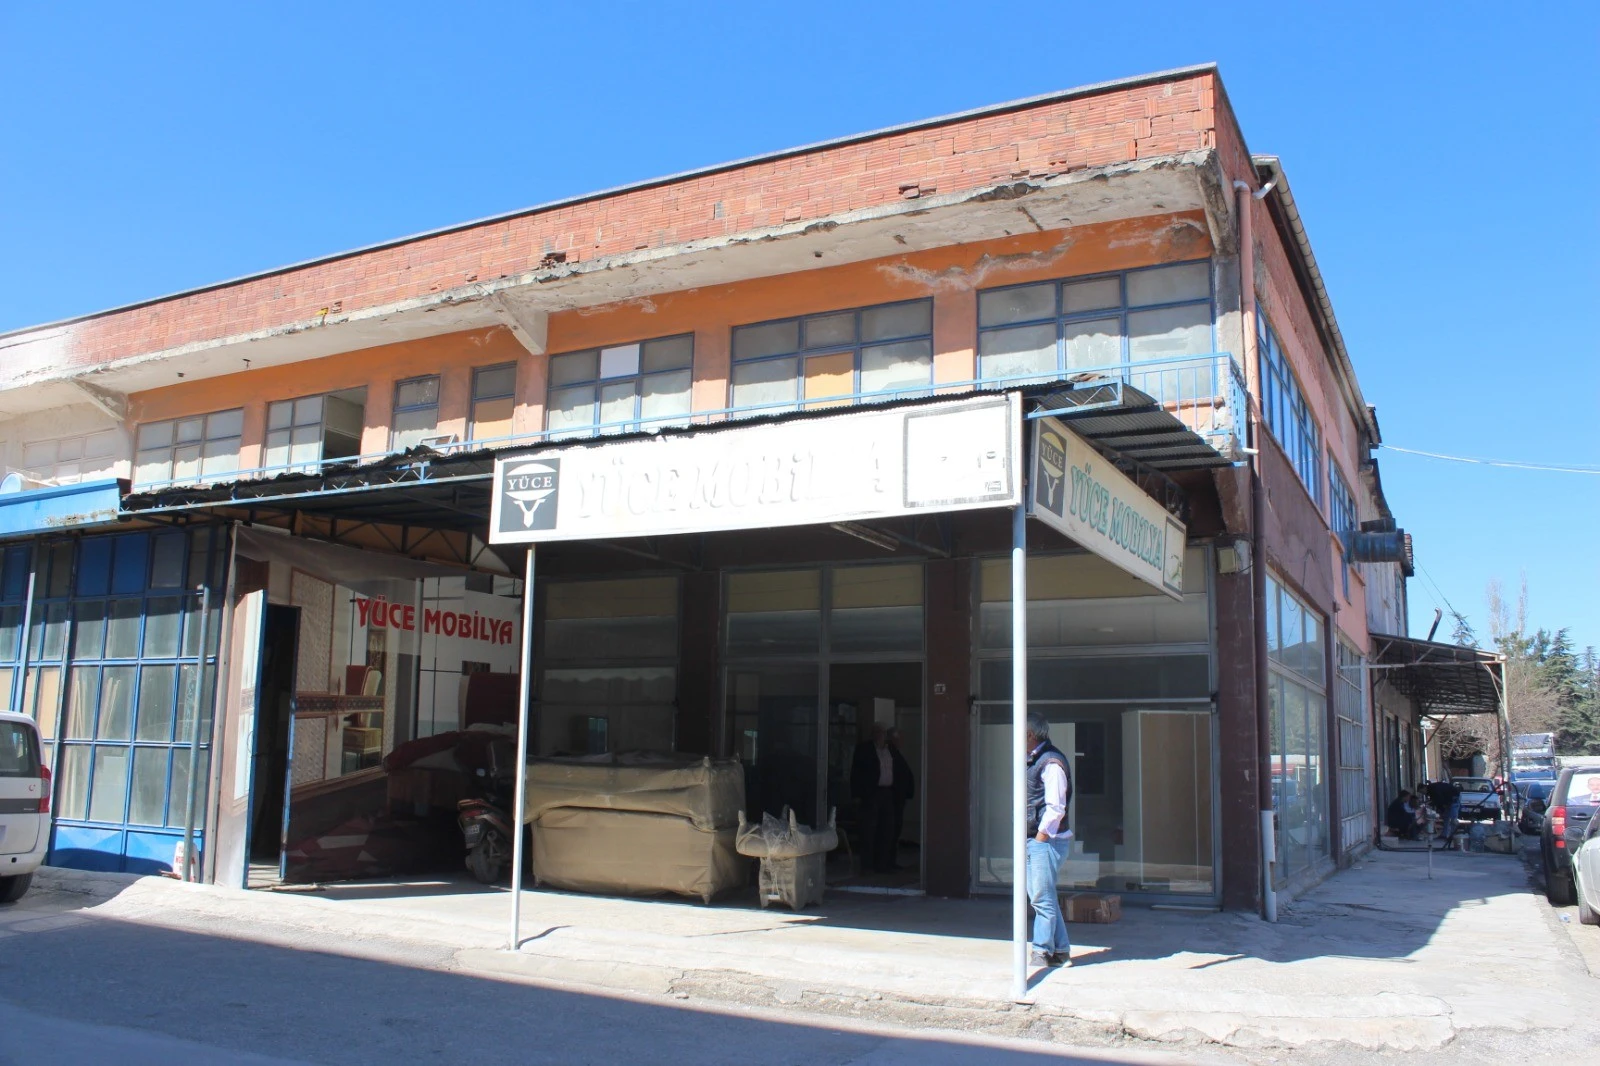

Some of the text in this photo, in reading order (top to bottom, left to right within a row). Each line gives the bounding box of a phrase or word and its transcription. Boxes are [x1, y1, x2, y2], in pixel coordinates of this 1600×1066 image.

[688, 440, 887, 511] MOBİLA
[1041, 441, 1063, 469] YÜCE
[507, 475, 553, 491] YÜCE
[1069, 462, 1163, 572] YÜCE MOBİLYA
[355, 594, 513, 646] YÜCE MOBİLYA
